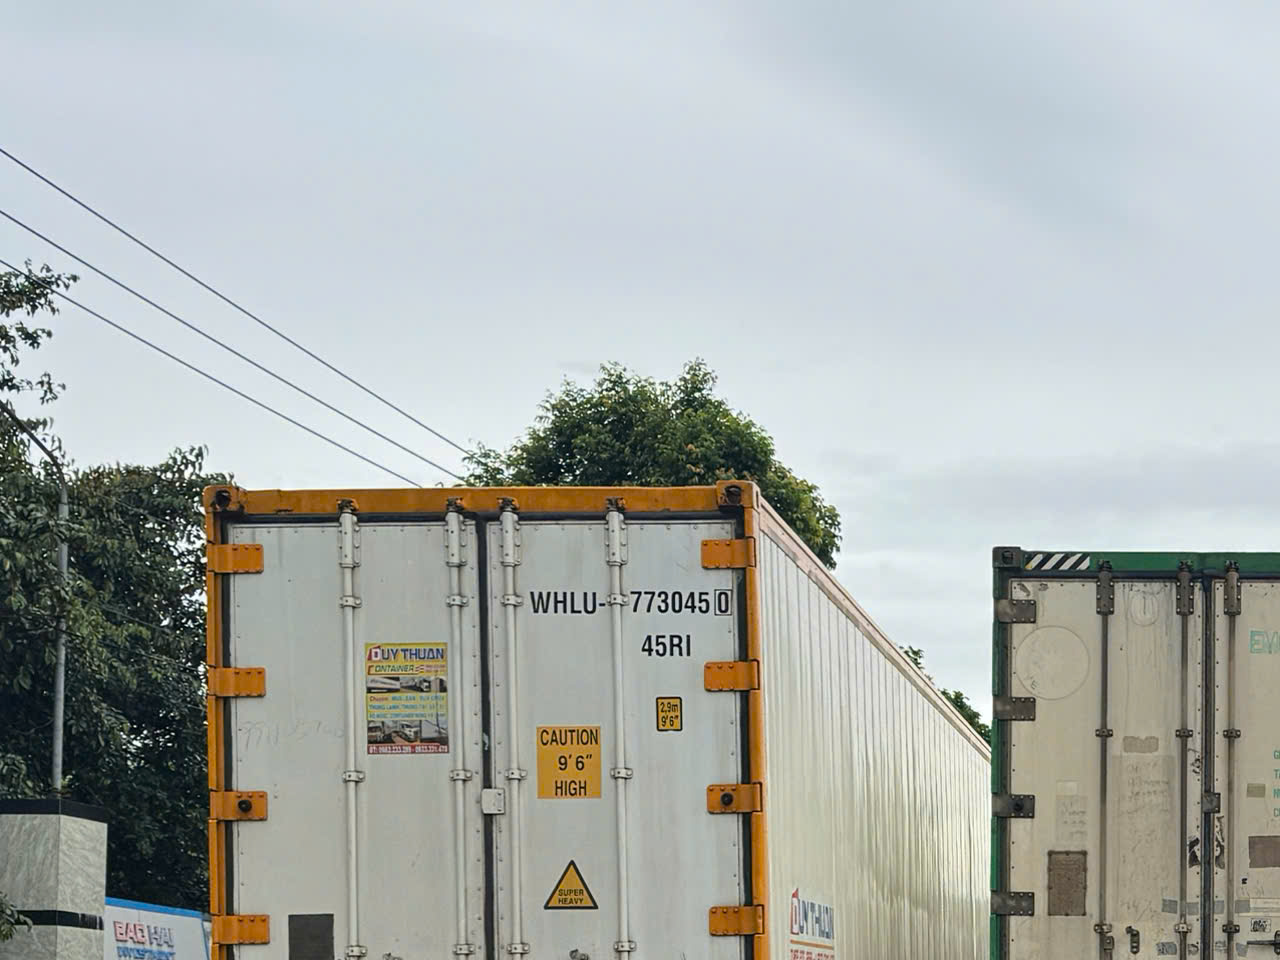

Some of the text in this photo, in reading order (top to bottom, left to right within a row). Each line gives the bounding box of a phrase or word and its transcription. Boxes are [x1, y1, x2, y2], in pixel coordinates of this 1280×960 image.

[630, 591, 710, 614] 773045
[540, 728, 598, 746] CAUTION
[555, 780, 587, 797] HIGH
[558, 889, 584, 897] SUPER
[558, 897, 584, 905] HEAVY
